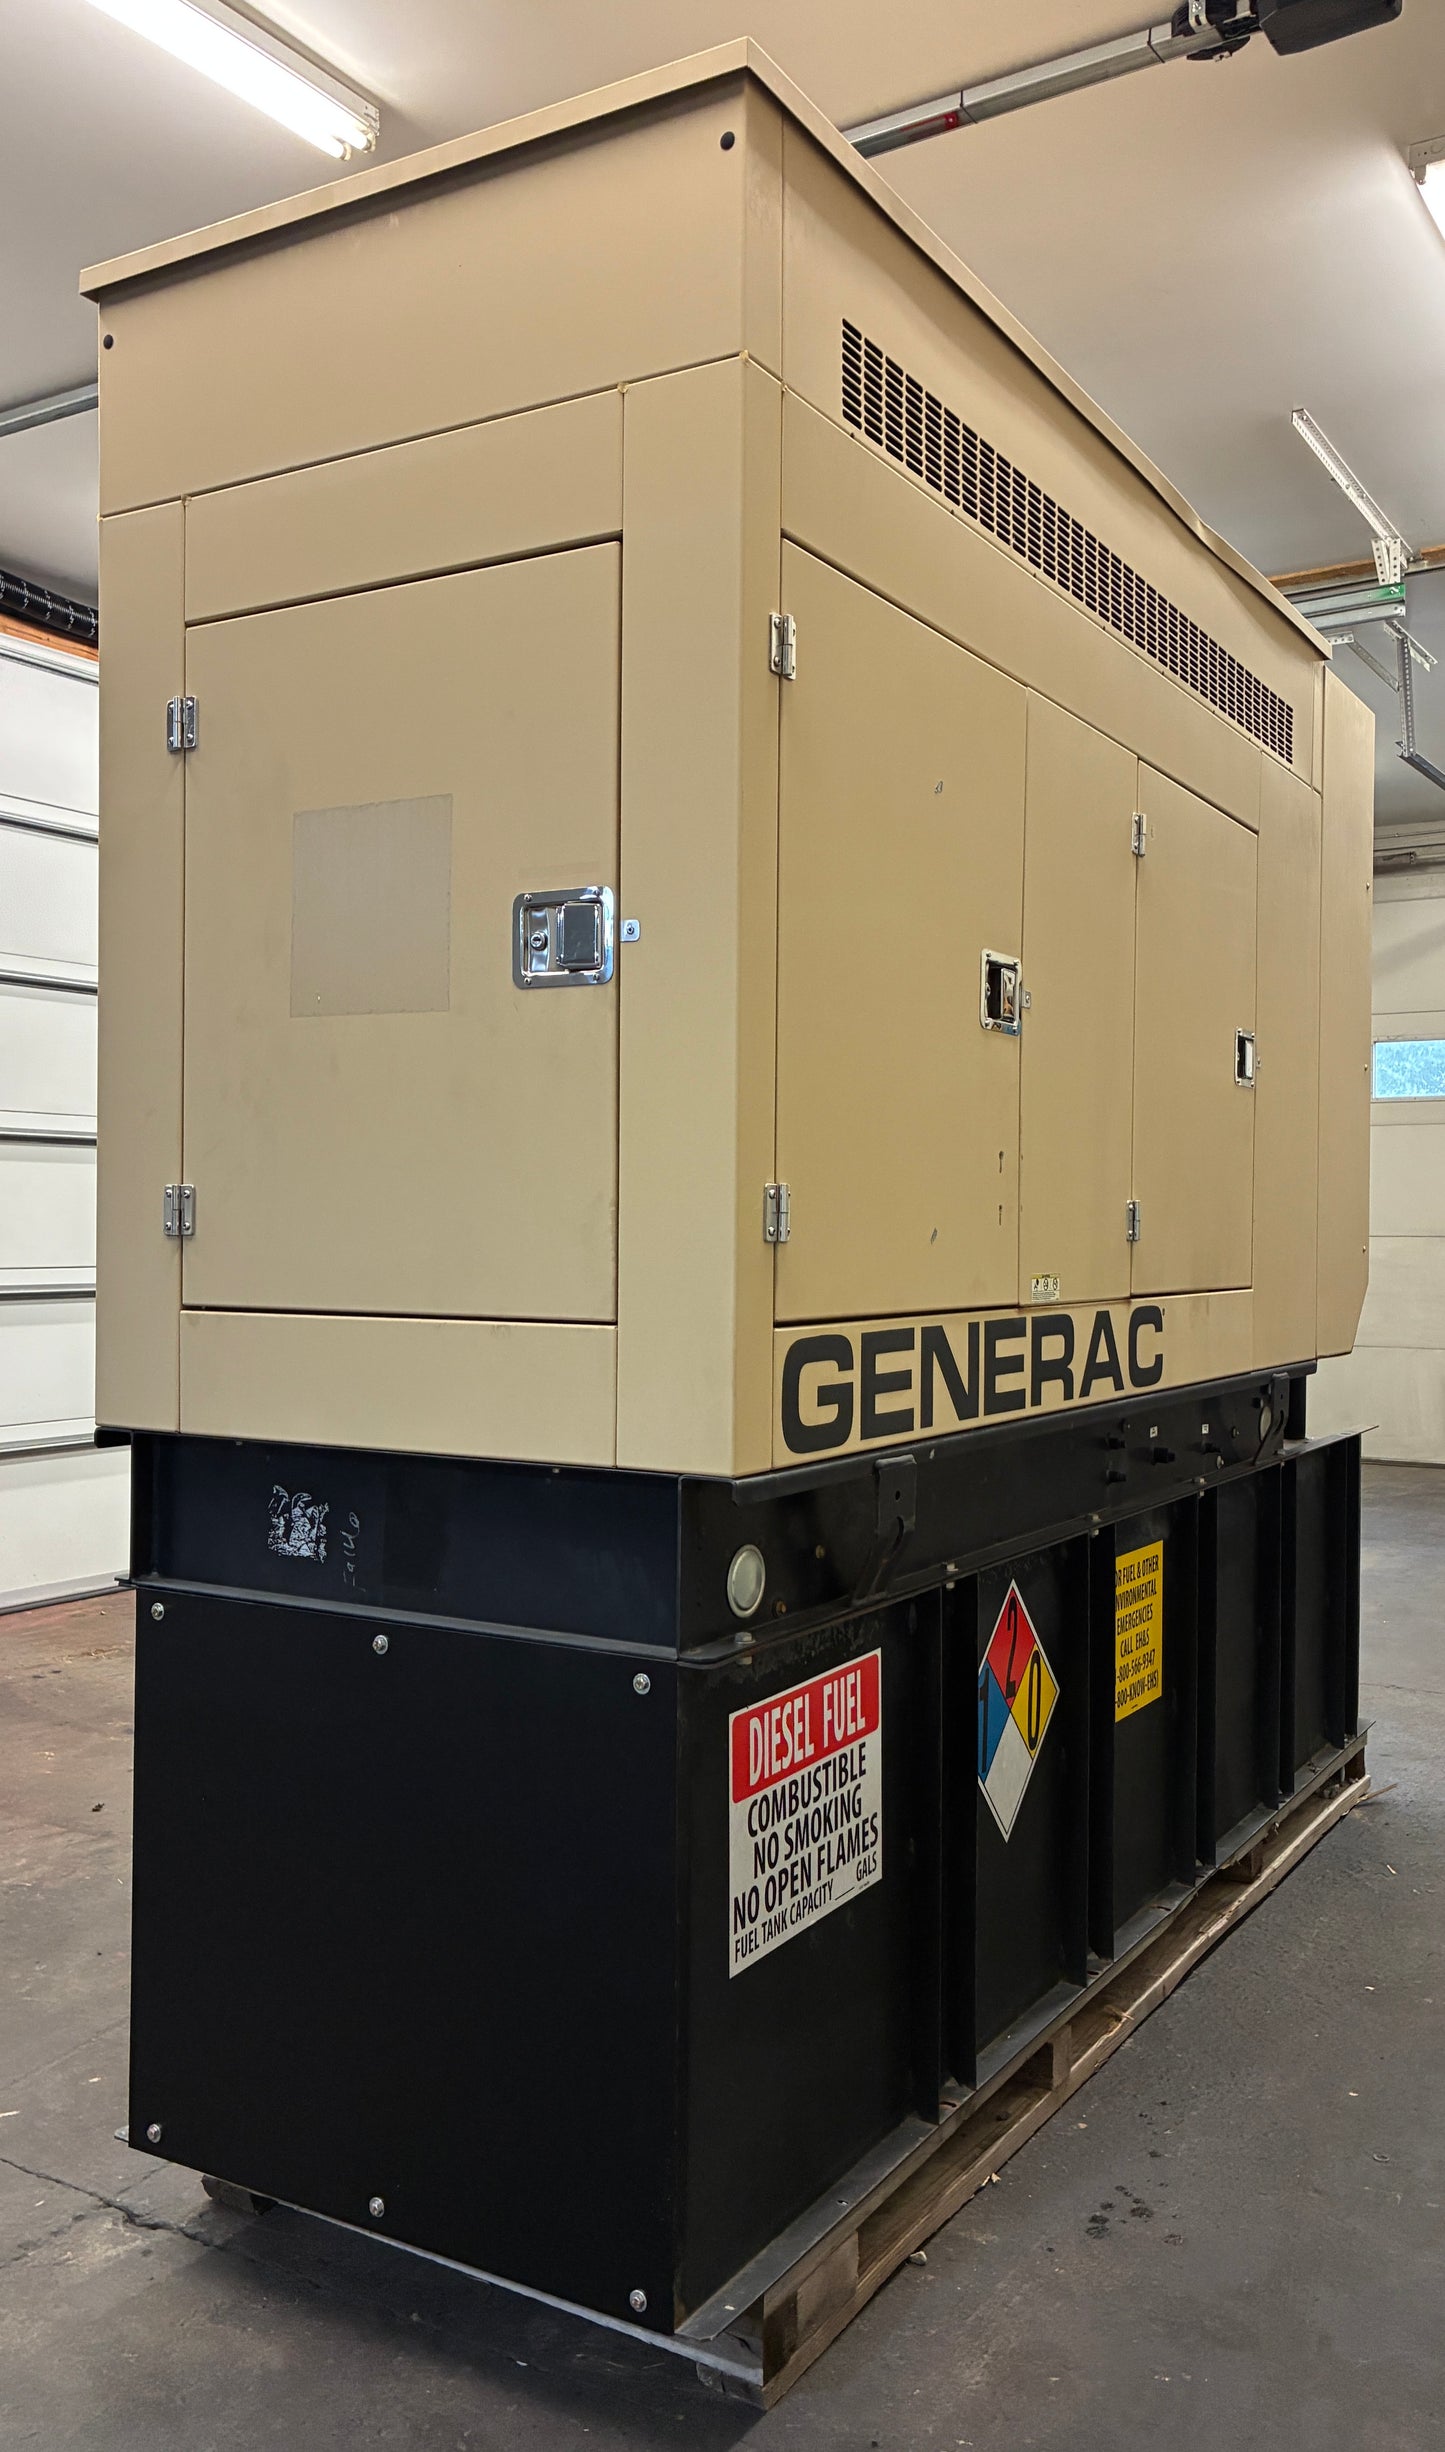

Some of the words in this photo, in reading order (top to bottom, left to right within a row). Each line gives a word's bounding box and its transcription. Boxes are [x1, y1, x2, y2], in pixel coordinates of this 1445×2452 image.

[781, 1305, 1164, 1454] GENERAC
[1115, 1578, 1157, 1612] NVIRONMENTAL
[1117, 1602, 1153, 1635] EMERGENCIES
[1122, 1563, 1136, 1585] FUEL
[1136, 1561, 1142, 1578] &
[1142, 1554, 1159, 1577] OTHER
[1006, 1596, 1018, 1699] 2
[1115, 1648, 1156, 1684] -800-566-9347
[1120, 1635, 1134, 1658] CALL
[749, 1692, 815, 1787] DIESEL
[823, 1668, 866, 1749] FUEL
[979, 1666, 990, 1774] 1
[1028, 1649, 1042, 1751] 0
[747, 1741, 867, 1838] COMBUSTIBLE
[754, 1831, 780, 1880] NO
[784, 1782, 862, 1861] SMOKING
[733, 1885, 760, 1936] NO
[764, 1852, 812, 1913] OPEN
[817, 1811, 879, 1882] FLAMES
[735, 1927, 760, 1963] FUEL
[761, 1907, 788, 1945] TANK
[790, 1878, 834, 1926] CAPACITY
[856, 1850, 877, 1882] GALS
